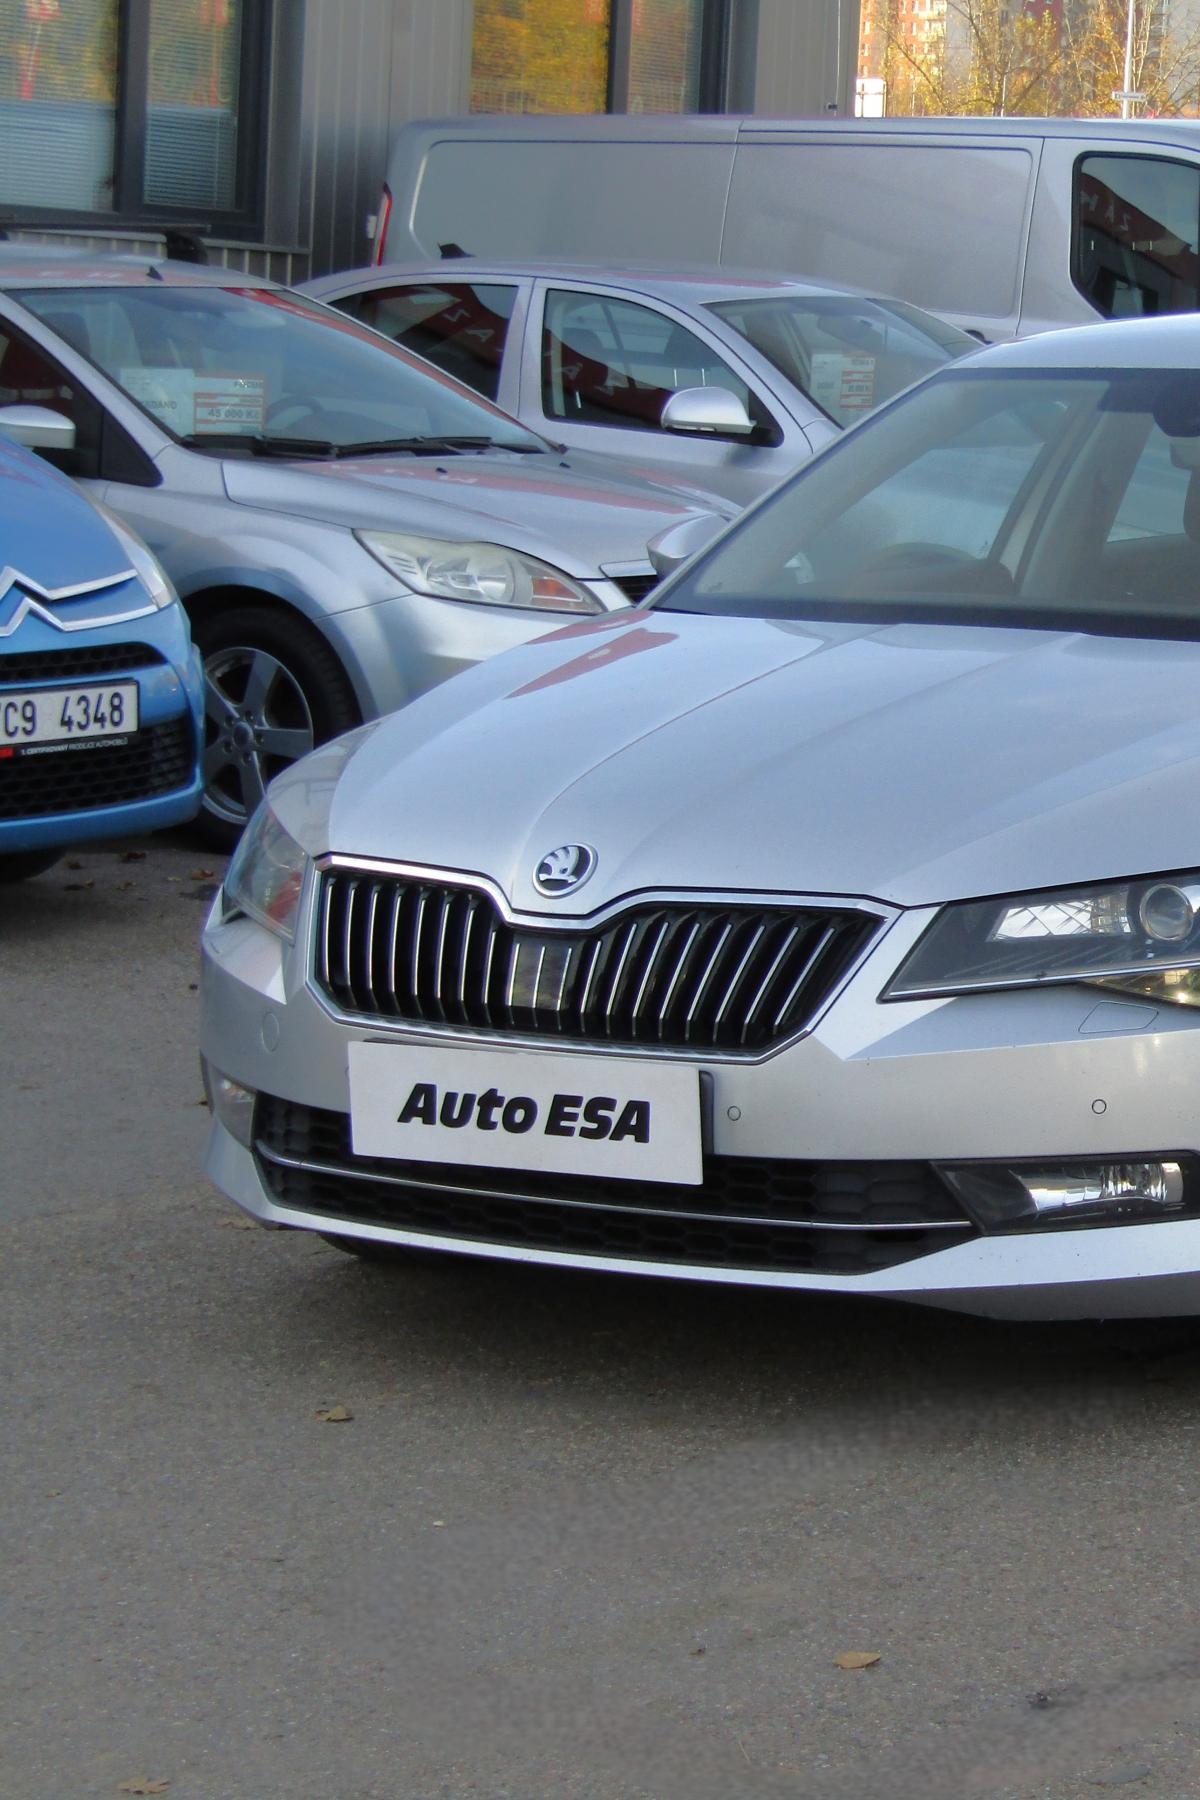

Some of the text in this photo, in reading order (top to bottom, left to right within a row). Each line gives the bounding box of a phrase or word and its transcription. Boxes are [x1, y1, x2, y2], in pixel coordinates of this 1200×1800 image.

[0, 691, 125, 737] C9 4348
[397, 1082, 651, 1144] Auto ESA
